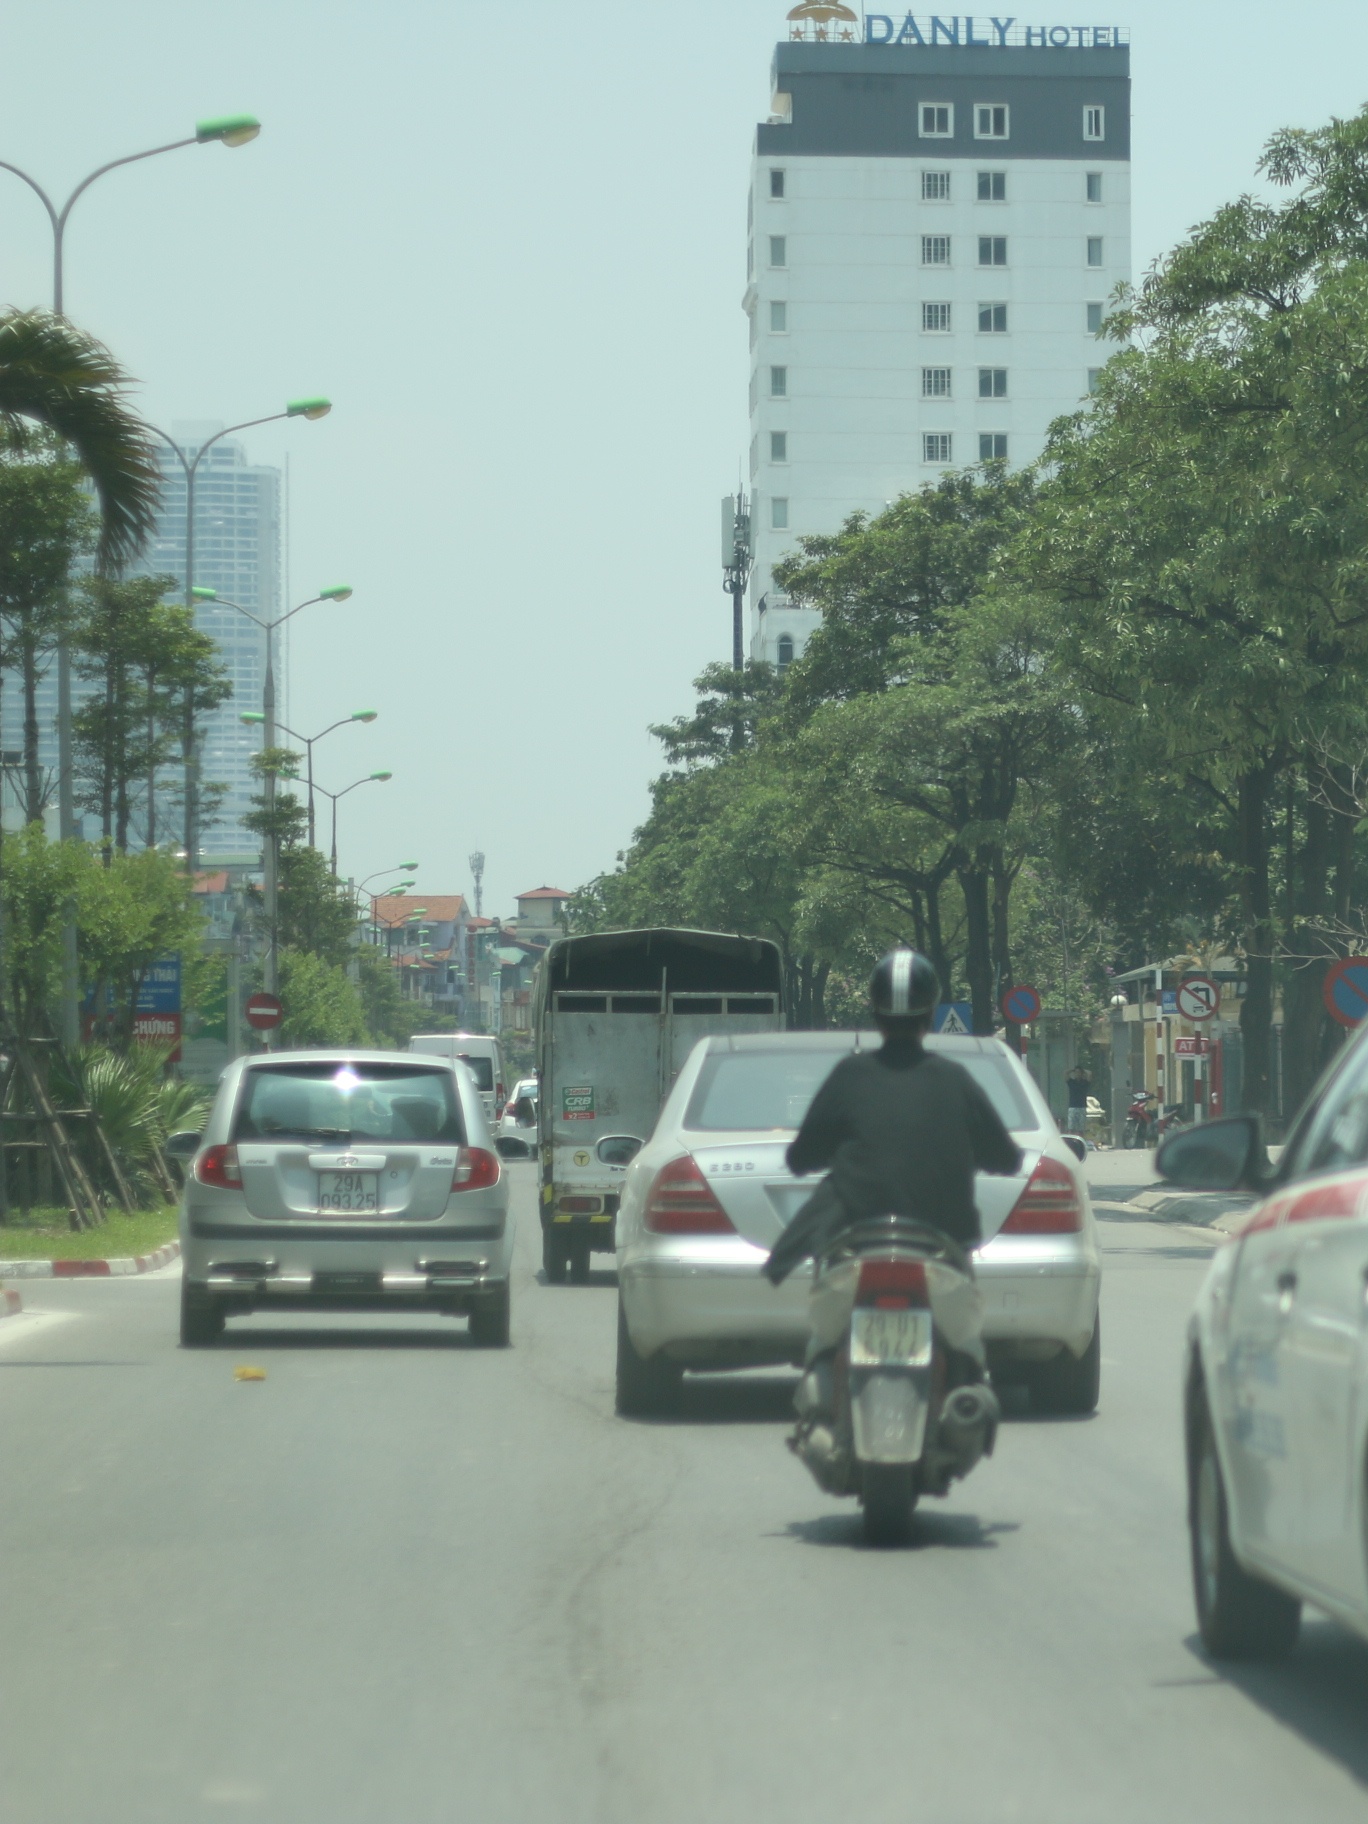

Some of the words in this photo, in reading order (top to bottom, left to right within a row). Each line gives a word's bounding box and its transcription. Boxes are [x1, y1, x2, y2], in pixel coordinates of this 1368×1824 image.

[864, 14, 1015, 46] DANLY
[1025, 26, 1130, 48] HOTEL
[565, 1097, 592, 1106] CRB
[333, 1174, 364, 1192] 29A
[320, 1193, 376, 1211] 093.25
